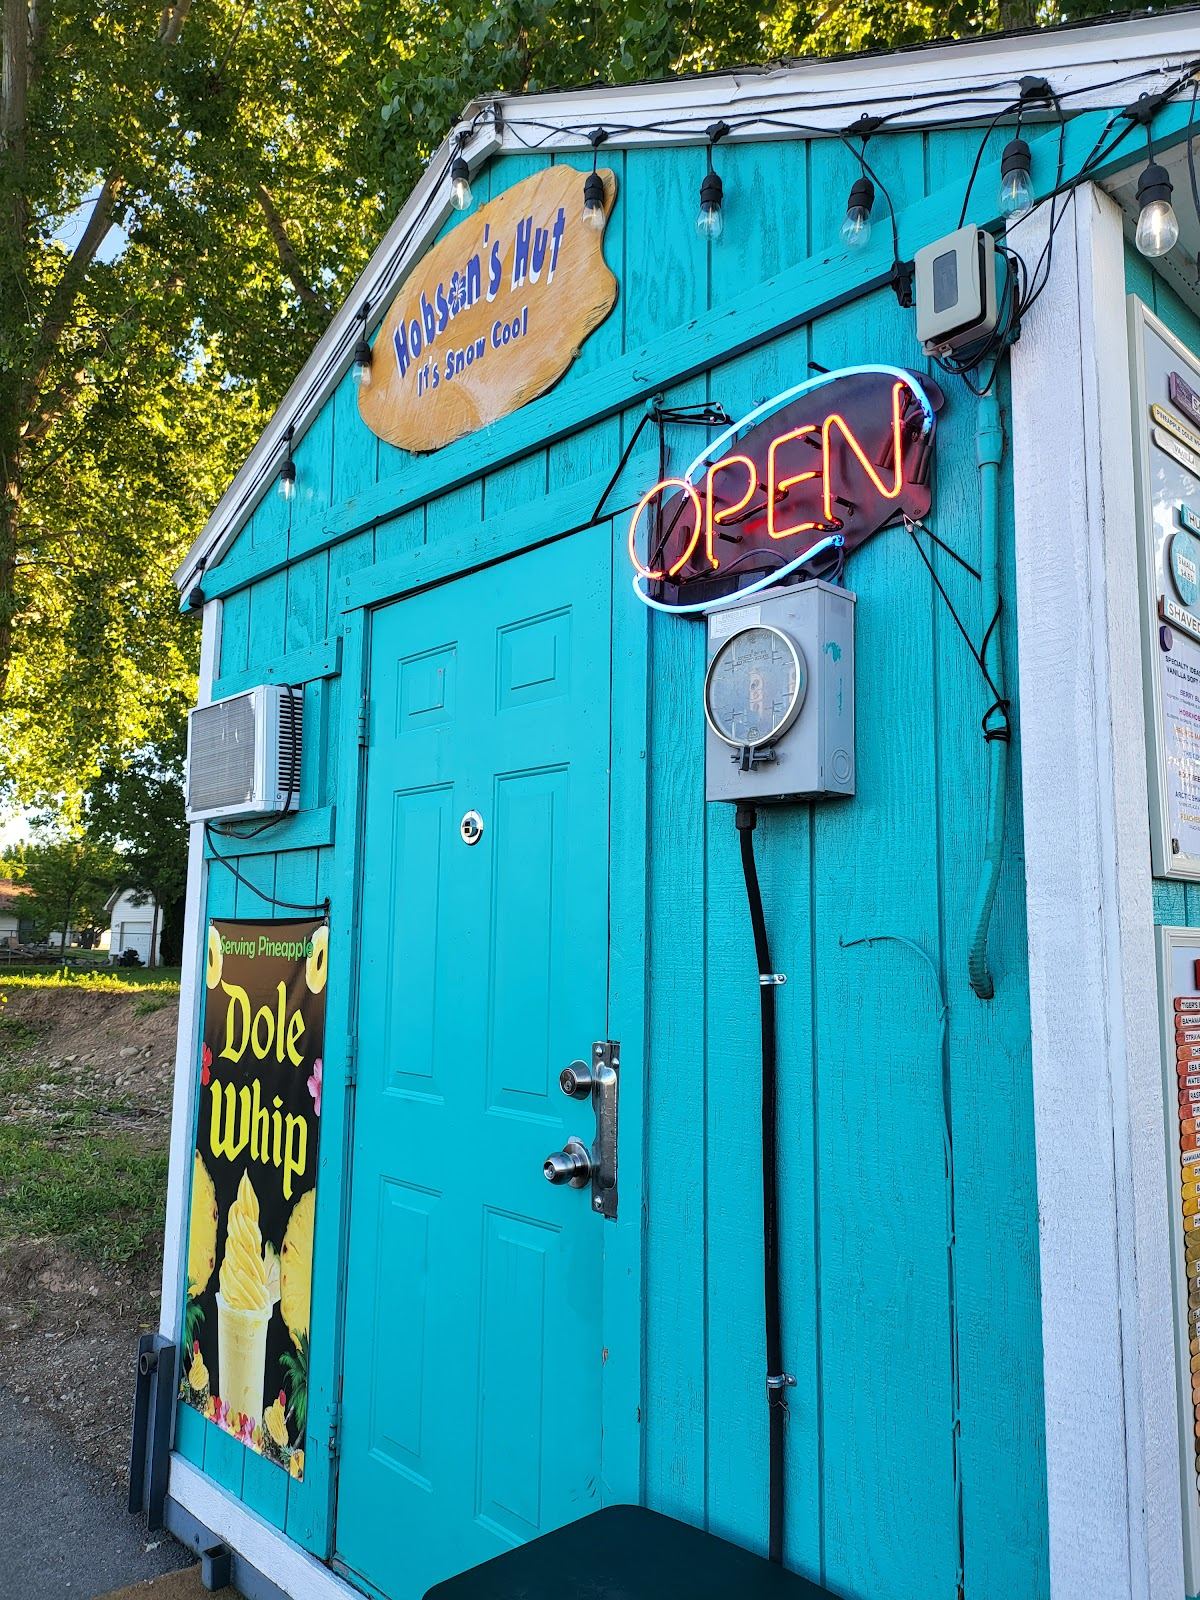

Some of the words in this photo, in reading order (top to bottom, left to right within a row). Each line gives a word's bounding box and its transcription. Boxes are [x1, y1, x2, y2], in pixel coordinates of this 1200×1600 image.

[393, 223, 502, 378] Hobson's
[511, 207, 566, 292] Hut
[418, 357, 440, 397] It's
[444, 336, 486, 381] Snow
[491, 305, 528, 350] Cool
[1156, 409, 1181, 433] PINEAPPLE
[1181, 429, 1193, 443] DOLE
[629, 380, 904, 580] OPEN
[1178, 556, 1195, 573] SMALL
[1165, 655, 1188, 671] SPECIALTY
[1166, 666, 1186, 680] VANILLA
[220, 935, 255, 959] Serving
[258, 935, 313, 961] Pineapple
[218, 980, 306, 1067] Dole
[209, 1077, 308, 1201] Whip
